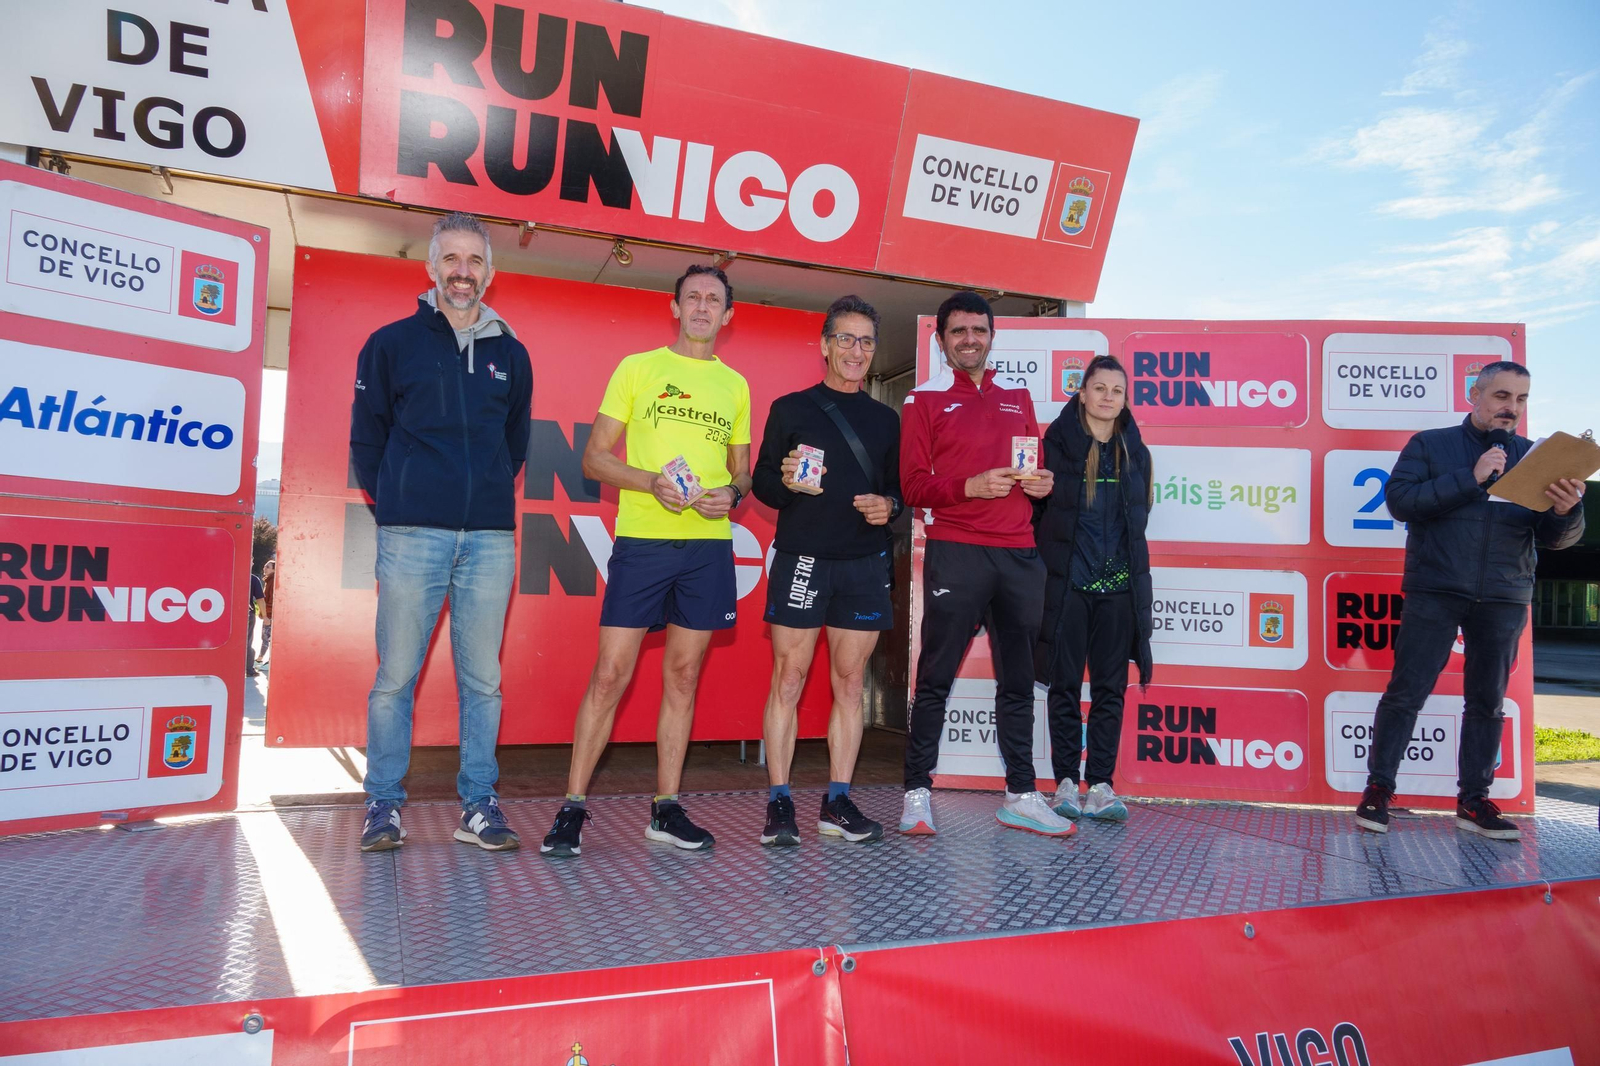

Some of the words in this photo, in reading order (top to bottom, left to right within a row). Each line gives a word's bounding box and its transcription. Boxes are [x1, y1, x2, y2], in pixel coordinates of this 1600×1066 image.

[106, 8, 210, 79] DE
[402, 0, 650, 118] RUN
[30, 75, 247, 158] VIGO
[921, 154, 1040, 193] CONCELLO
[930, 183, 958, 206] DE
[968, 190, 1021, 217] VIGO
[22, 229, 162, 274] CONCELLO
[38, 256, 74, 279] DE
[84, 264, 146, 292] VIGO
[989, 361, 1038, 374] ELLO
[1133, 351, 1211, 378] RUN
[1337, 364, 1438, 380] CONCELLO
[1349, 383, 1373, 398] DE
[1380, 384, 1426, 398] VIGO
[0, 386, 234, 450] Atlántico
[657, 404, 732, 431] castrelos
[1207, 479, 1226, 510] que
[1229, 484, 1297, 514] auga
[0, 542, 110, 582] RUN
[1152, 600, 1235, 616] ONCELLO
[1152, 617, 1175, 631] DE
[1181, 618, 1224, 633] VIGO
[1136, 704, 1217, 735] RUN
[0, 723, 130, 748] ONCELLO
[948, 728, 972, 743] DE
[978, 729, 997, 743] VI
[0, 752, 37, 773] DE
[48, 747, 112, 769] VIGO
[1400, 746, 1434, 761] GO
